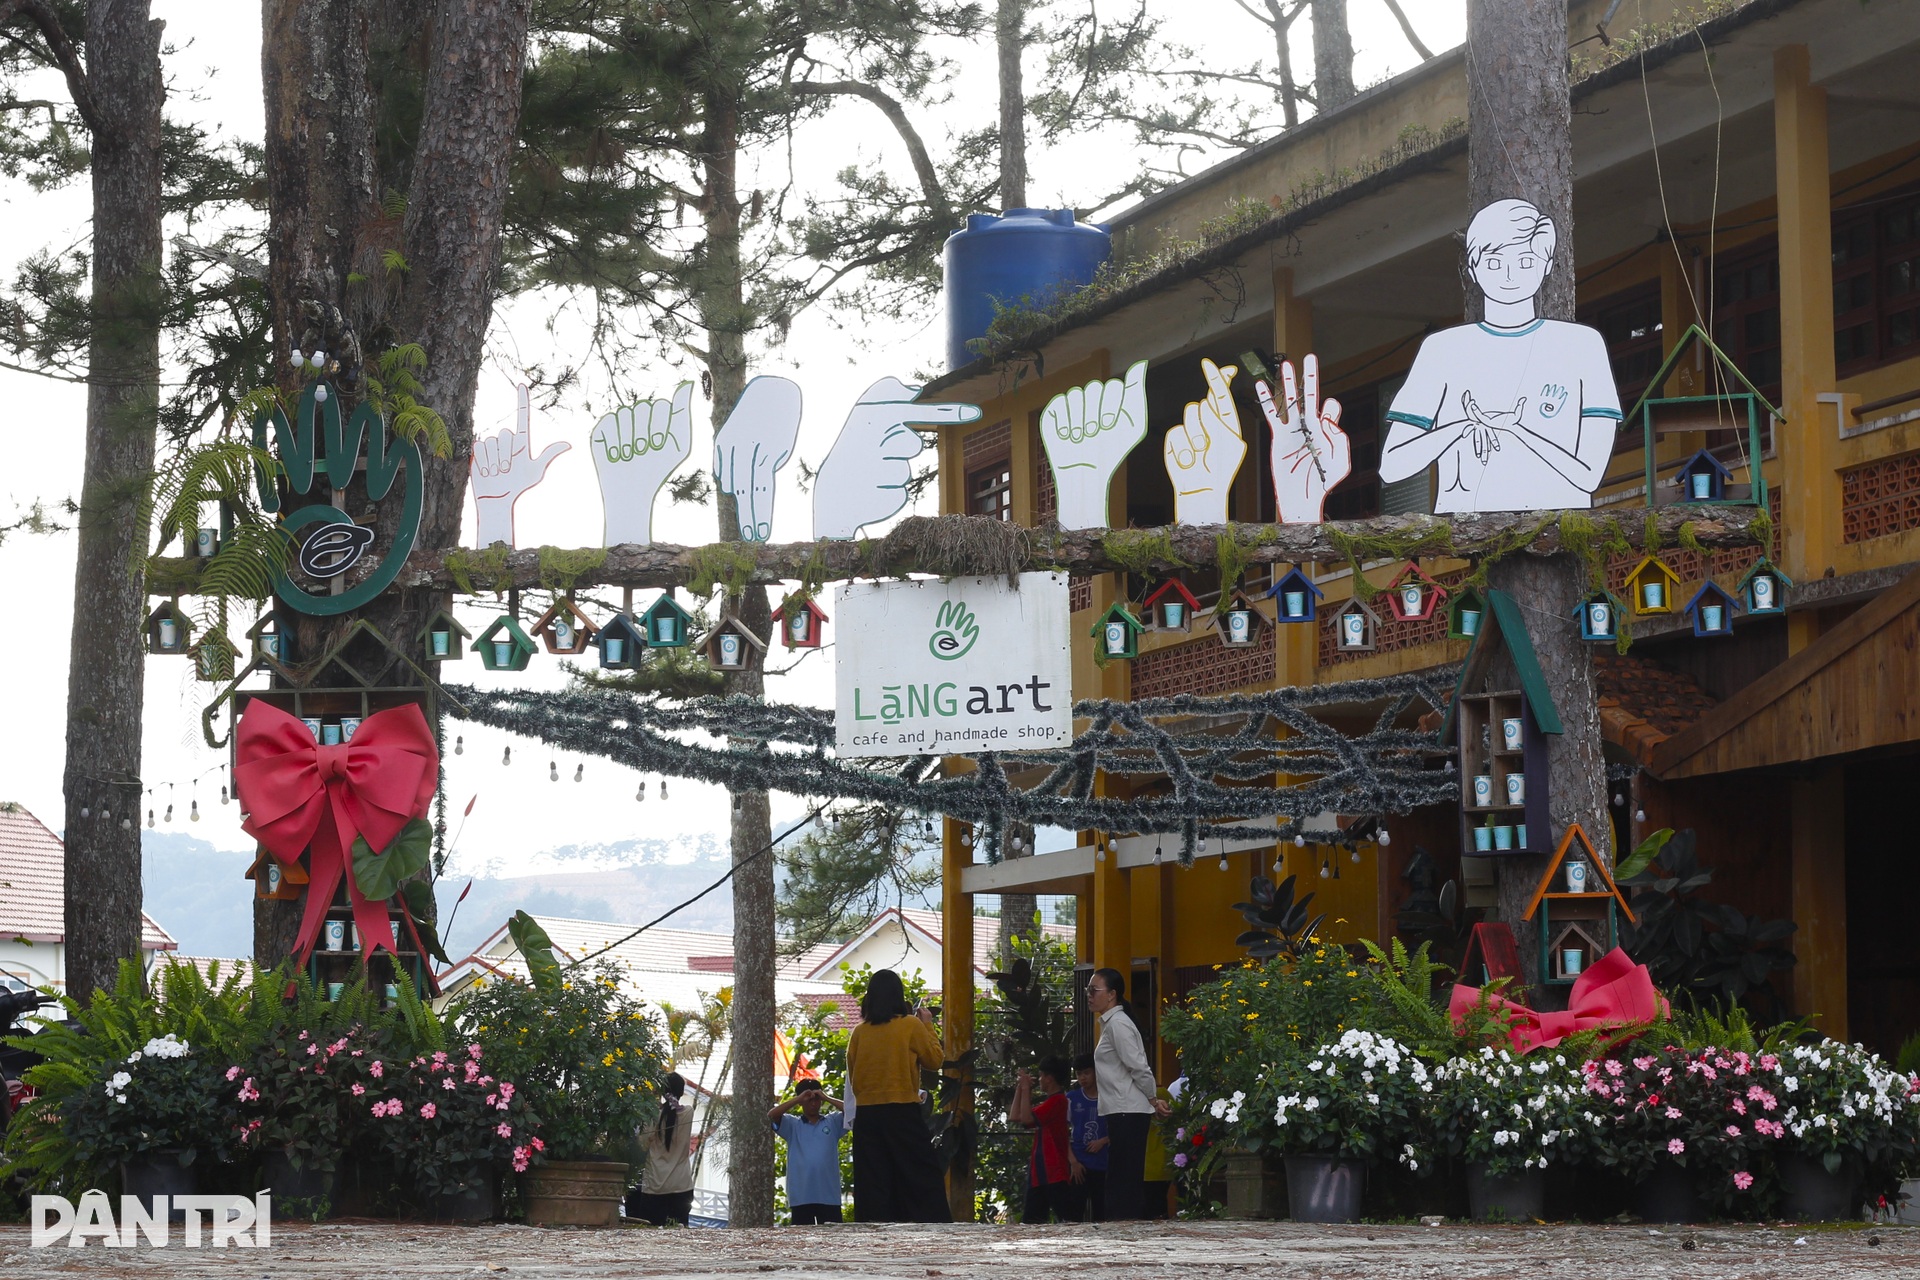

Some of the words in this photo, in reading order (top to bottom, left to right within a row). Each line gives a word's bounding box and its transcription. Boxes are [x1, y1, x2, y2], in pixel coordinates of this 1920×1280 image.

[966, 675, 1052, 715] art
[852, 732, 888, 746] cafe
[898, 730, 925, 744] and
[935, 726, 1008, 741] handmade
[1018, 724, 1055, 740] shop
